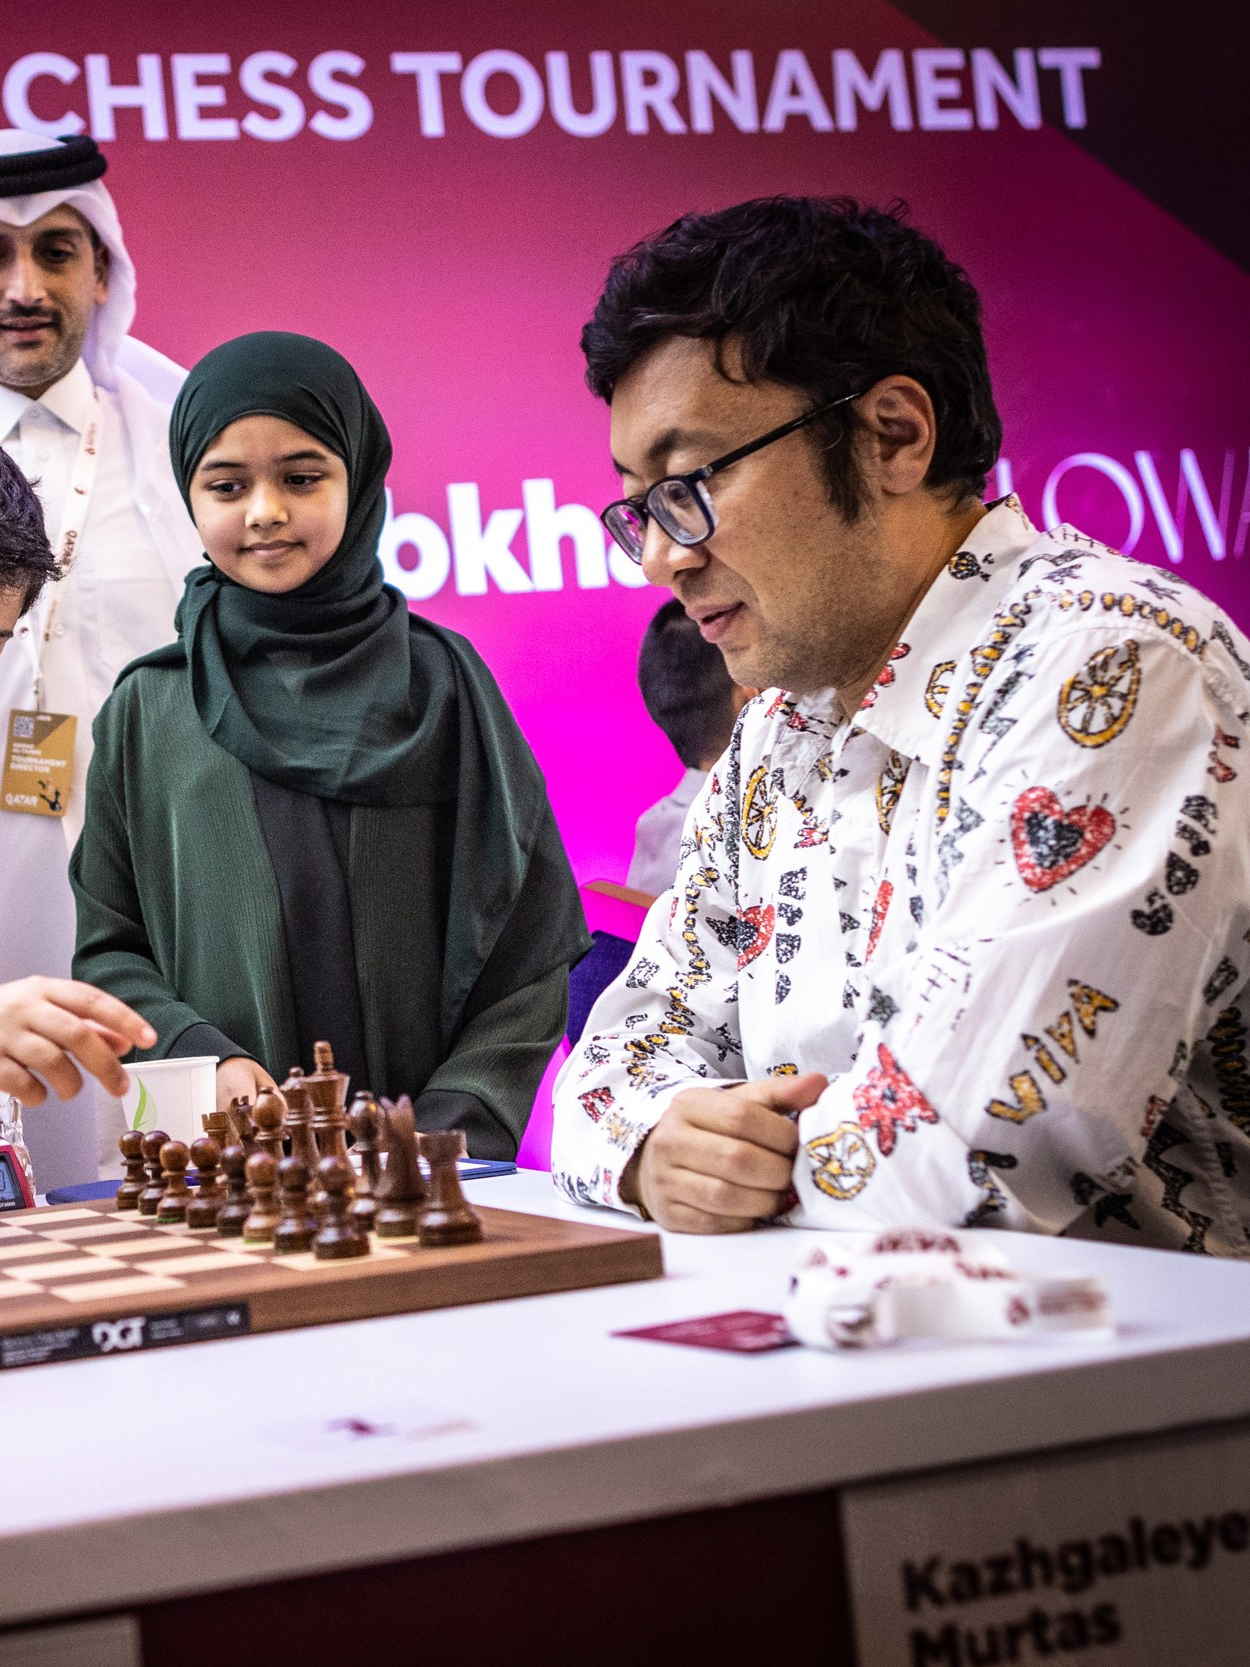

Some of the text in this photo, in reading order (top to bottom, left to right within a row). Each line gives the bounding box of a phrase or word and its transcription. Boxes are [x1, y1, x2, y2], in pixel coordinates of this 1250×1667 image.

[2, 50, 373, 142] CHESS
[391, 47, 1101, 138] TOURNAMENT
[5, 793, 38, 807] QATAR
[91, 1316, 146, 1352] DGT
[903, 1510, 1250, 1612] Kazhgaleye
[910, 1602, 1122, 1667] Murtas
